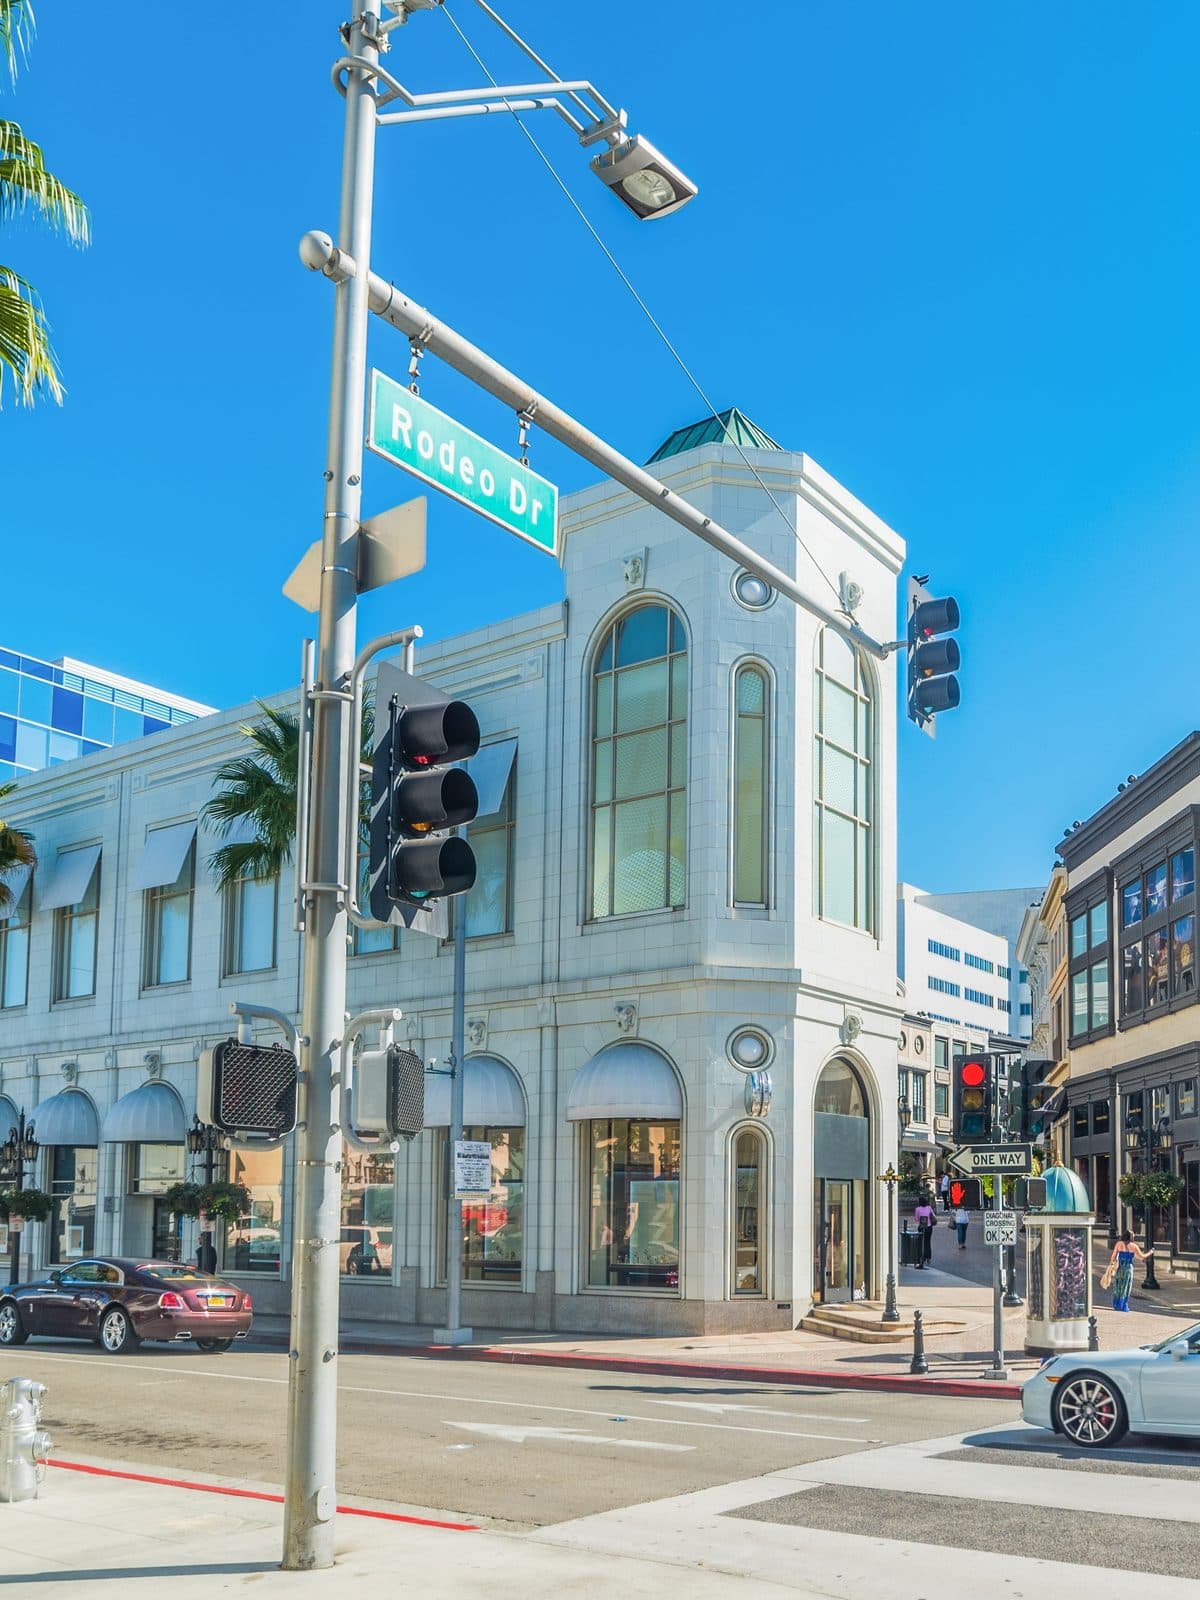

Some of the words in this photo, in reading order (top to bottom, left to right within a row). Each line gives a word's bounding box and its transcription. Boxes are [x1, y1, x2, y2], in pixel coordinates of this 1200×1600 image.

[391, 402, 495, 497] Rodeo
[510, 477, 543, 525] Dr
[973, 1154, 995, 1166] ONE
[999, 1153, 1022, 1165] WAY
[986, 1231, 997, 1241] OK
